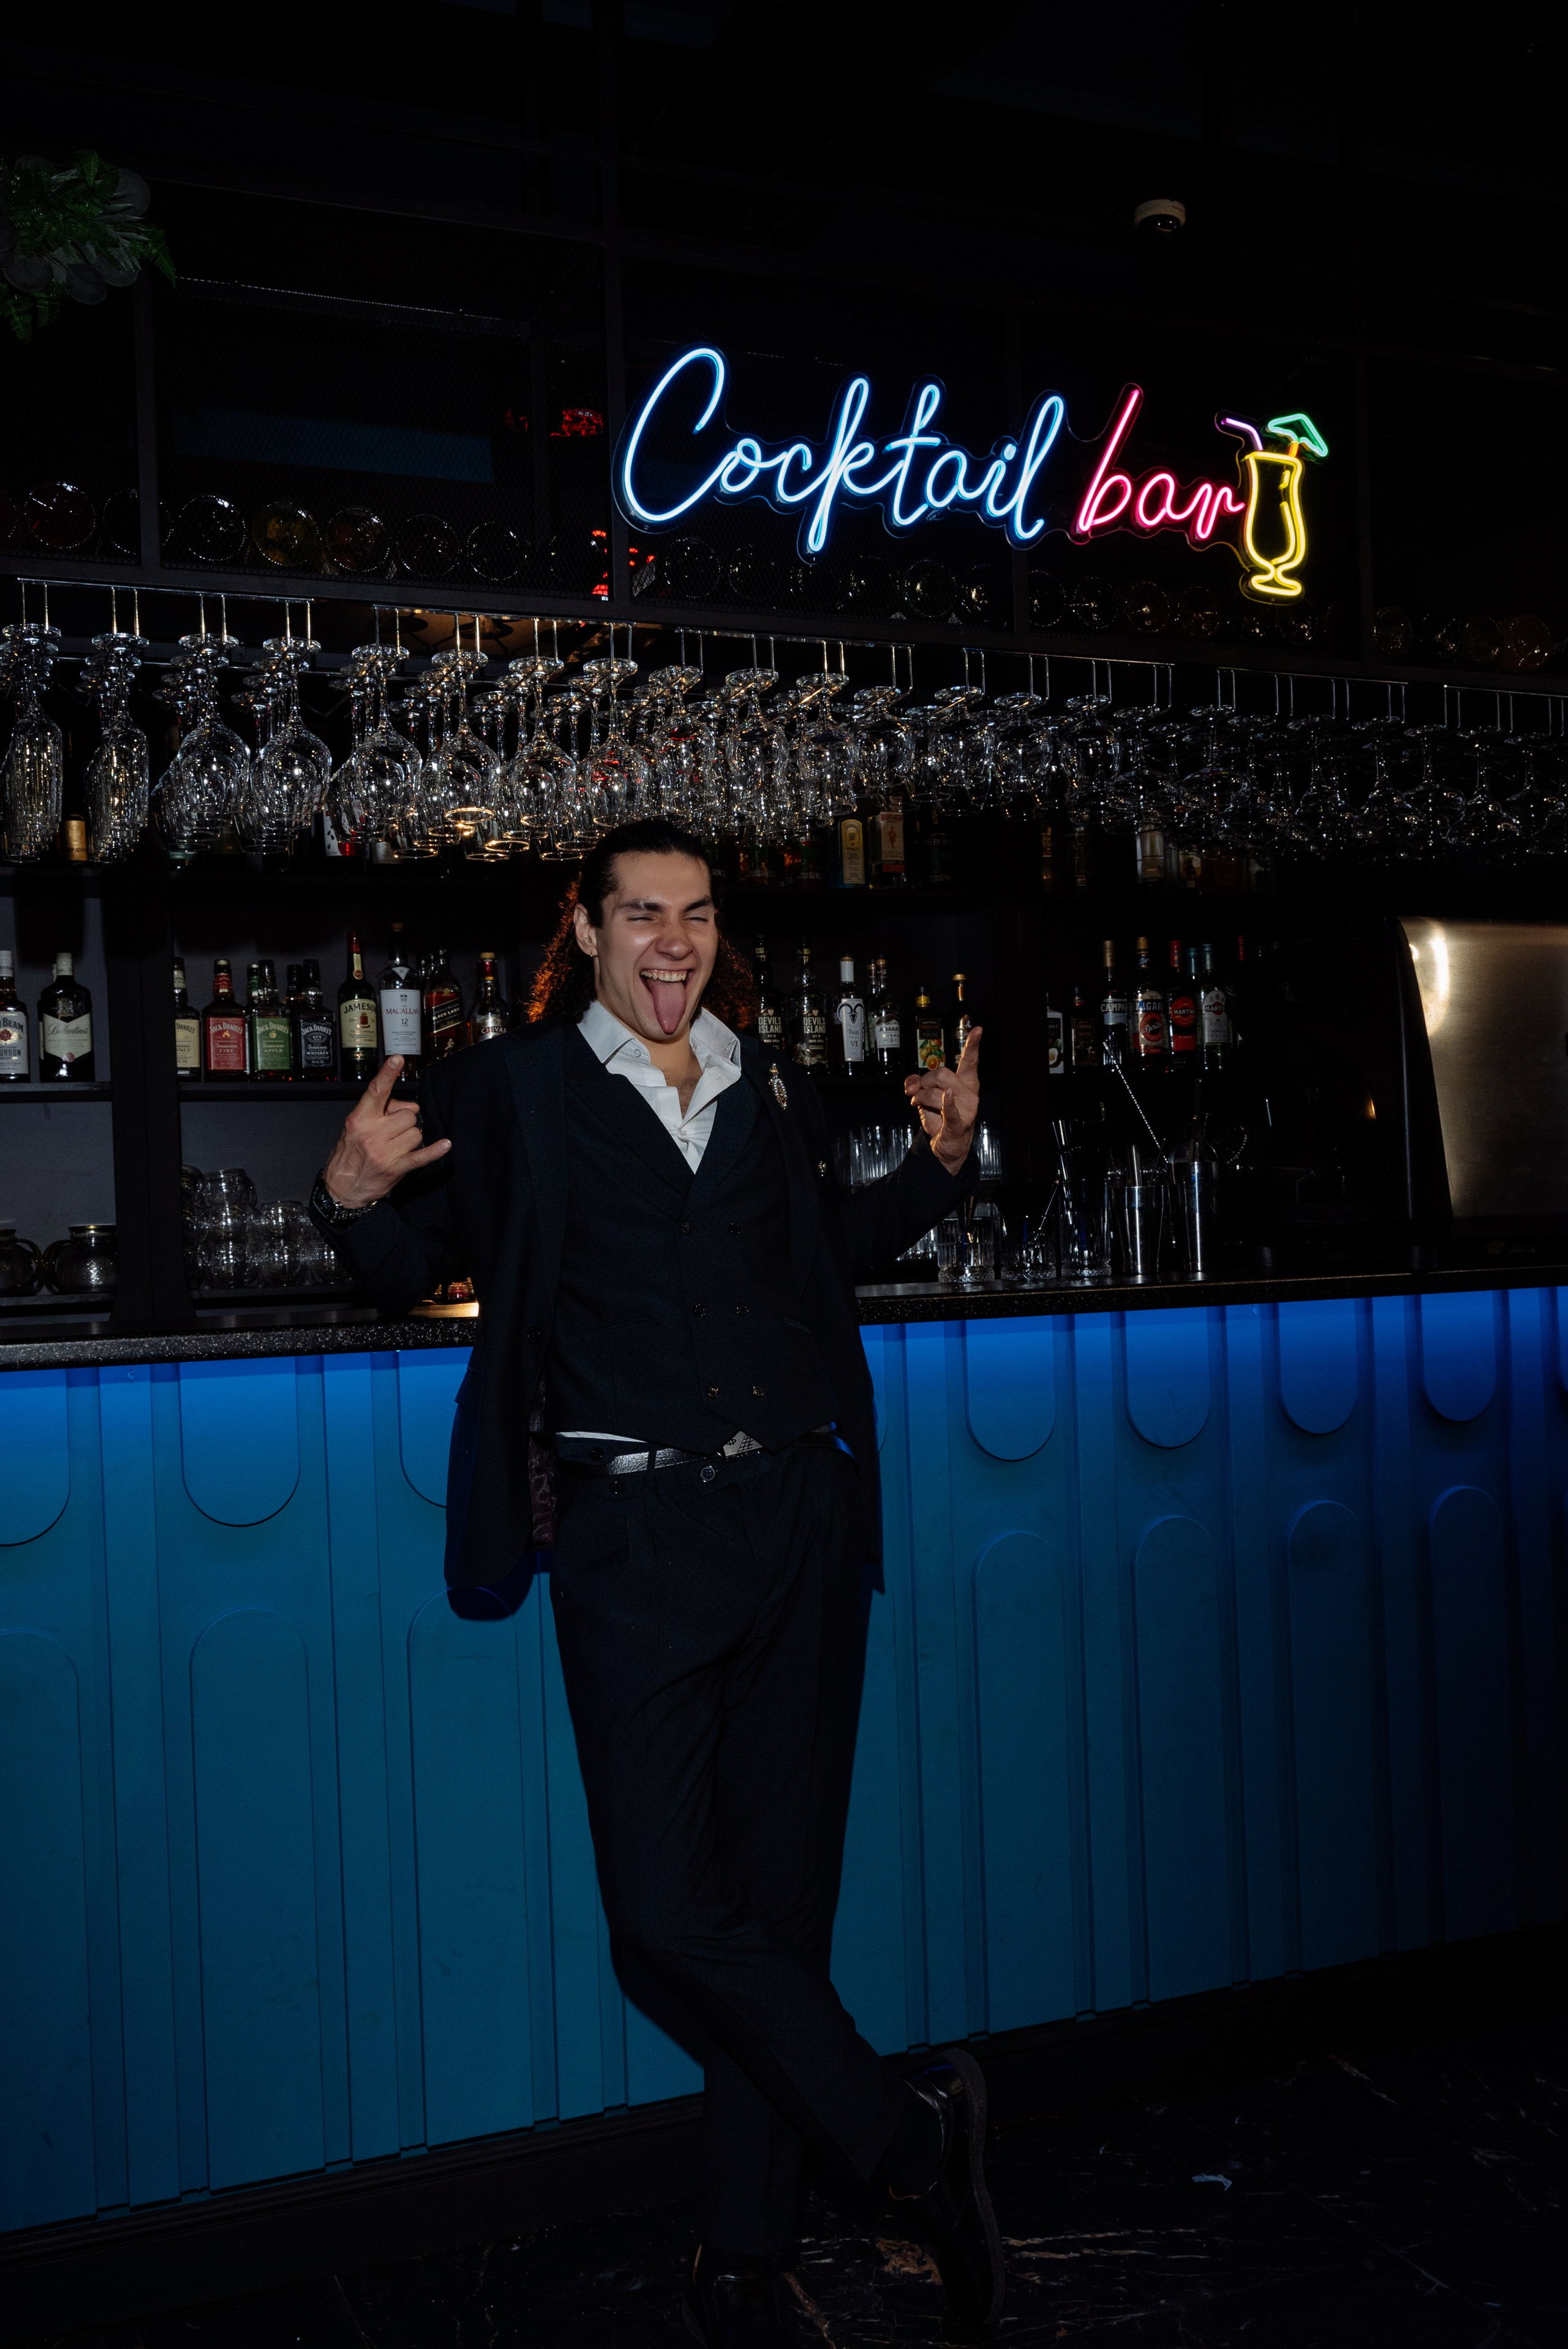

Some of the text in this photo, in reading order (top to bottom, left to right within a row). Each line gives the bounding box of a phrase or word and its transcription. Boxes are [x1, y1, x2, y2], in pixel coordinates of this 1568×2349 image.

[623, 347, 1246, 554] Cocktail bar
[1101, 1003, 1127, 1012] CAMPA
[758, 1017, 782, 1025] DEVILS
[803, 1017, 826, 1025] DEVILS
[313, 1024, 333, 1035] DANIEL'S
[758, 1025, 783, 1034] ISLAND
[803, 1025, 827, 1034] ISLAND
